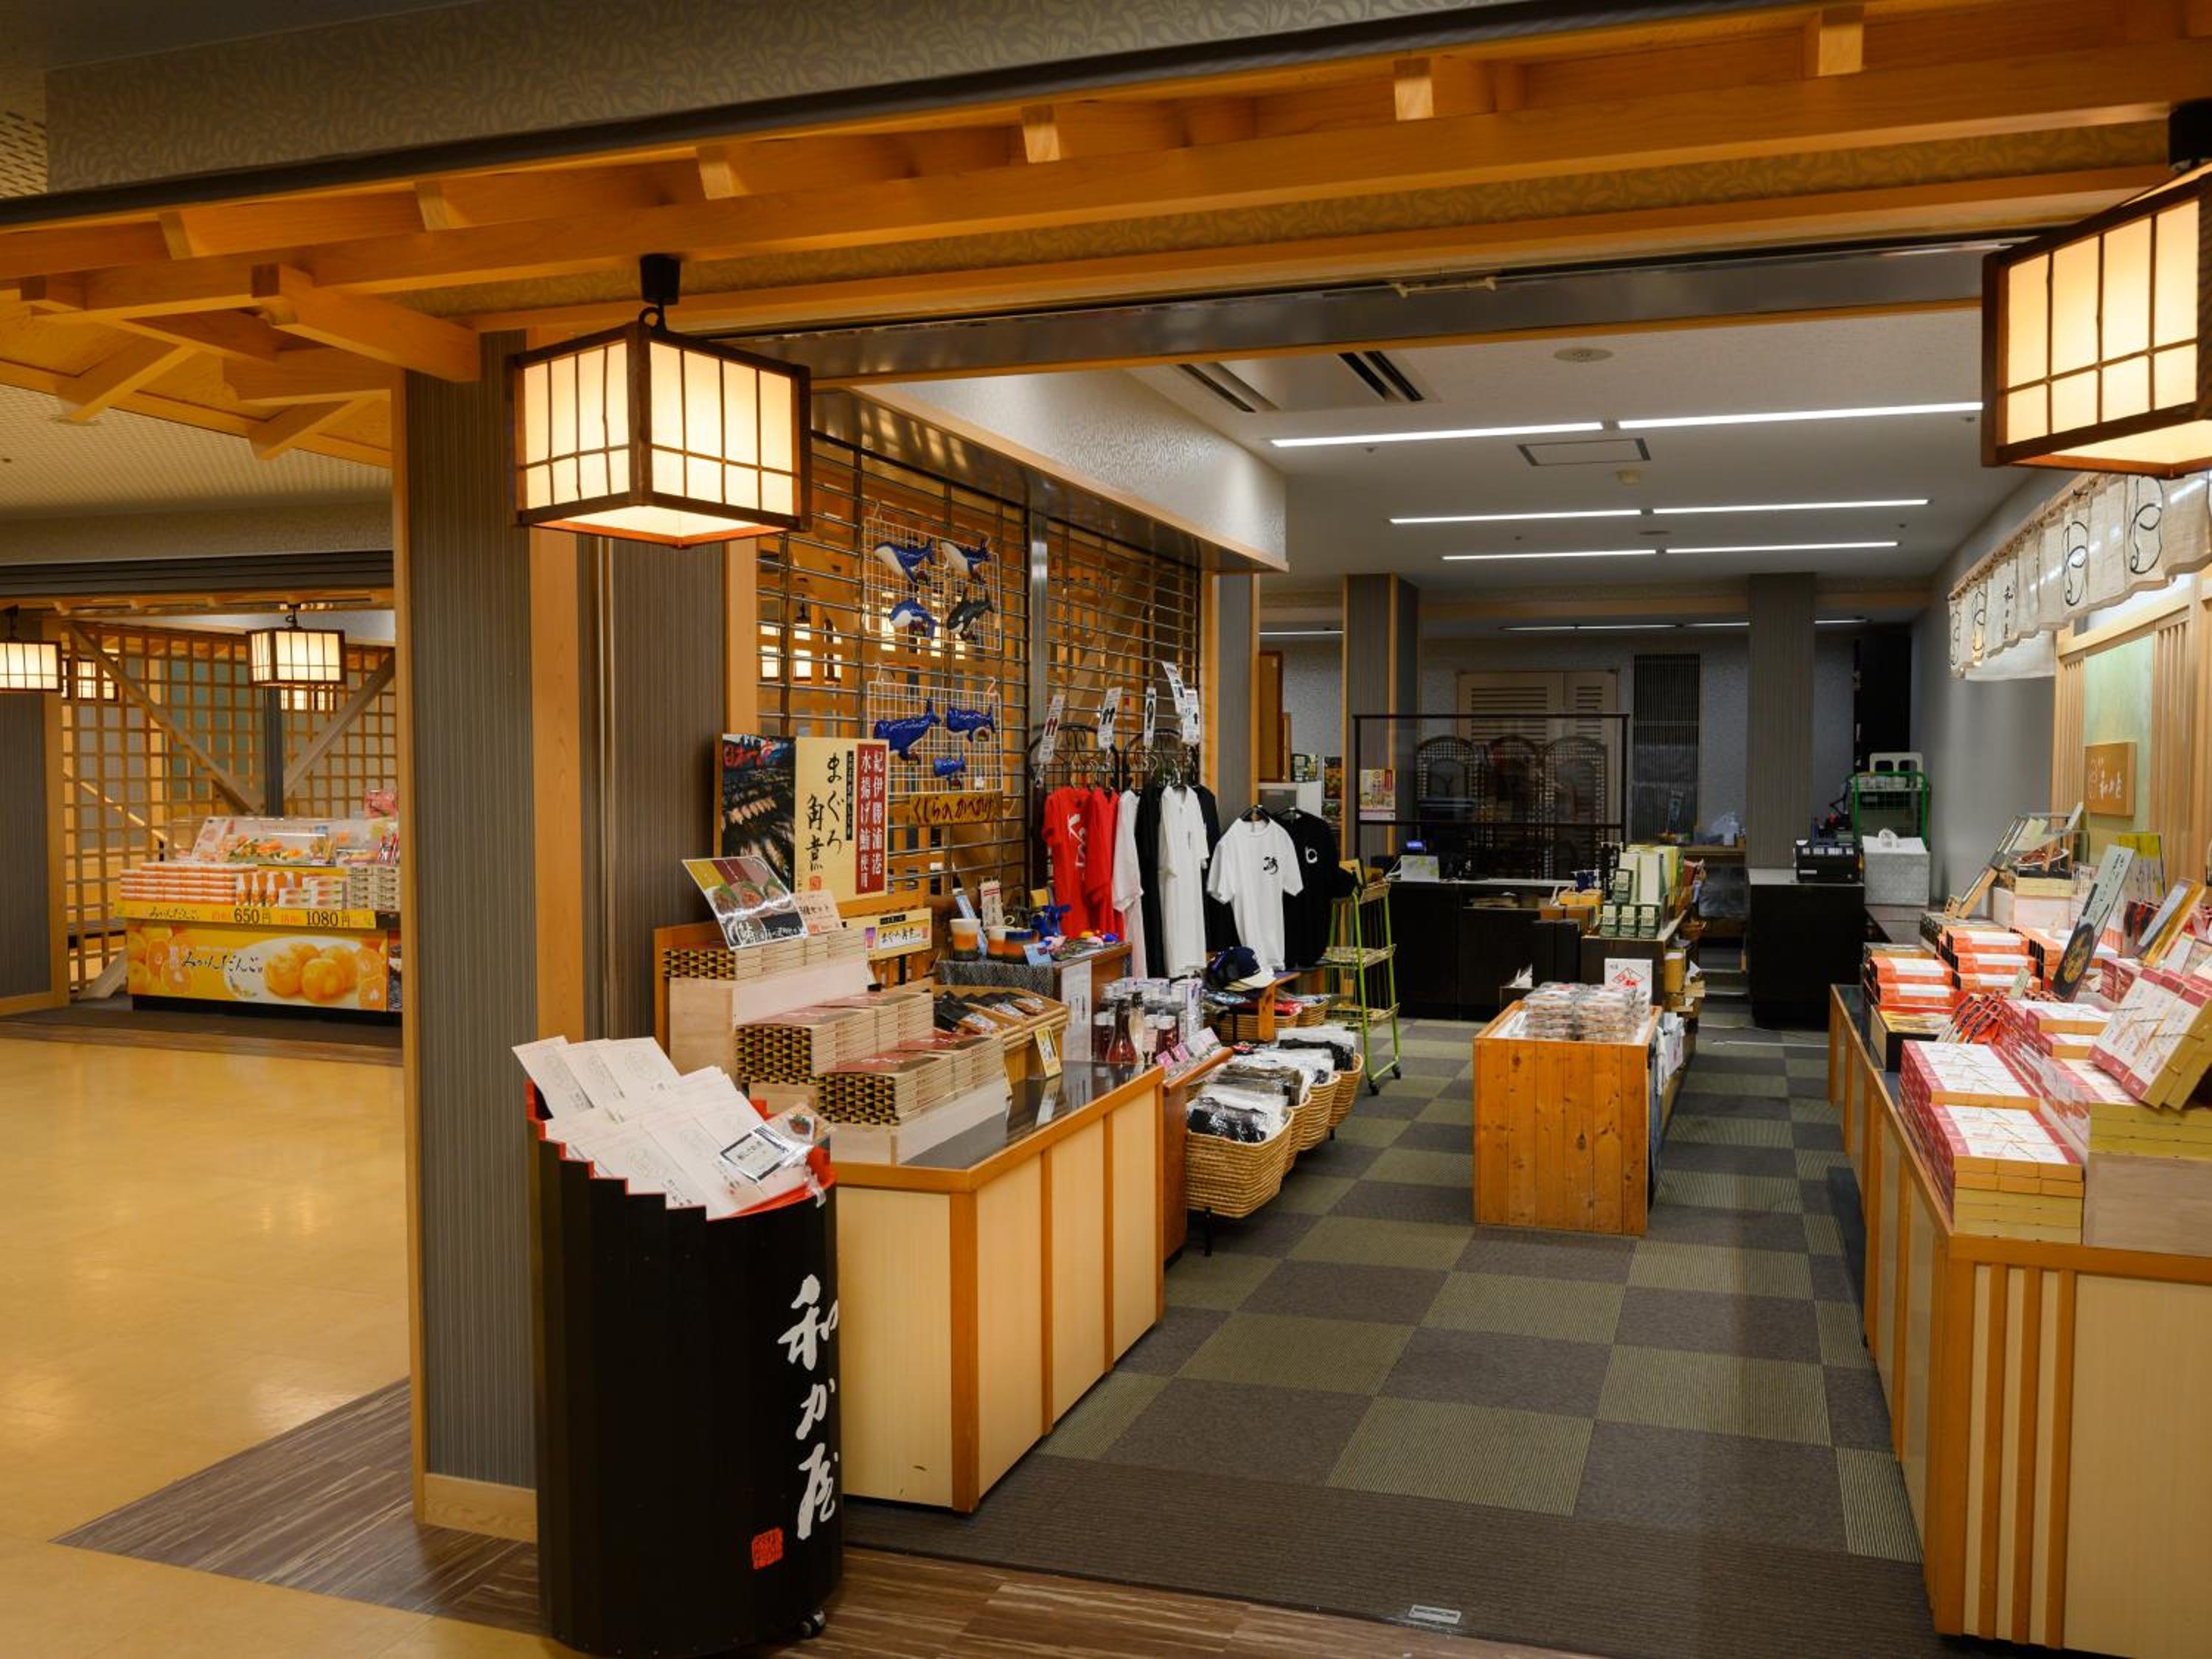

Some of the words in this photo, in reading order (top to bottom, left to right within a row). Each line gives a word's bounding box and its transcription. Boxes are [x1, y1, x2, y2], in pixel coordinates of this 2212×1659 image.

[805, 793, 824, 872] 角煮
[827, 751, 844, 855] まぐろ
[777, 1273, 839, 1540] 和か屋
